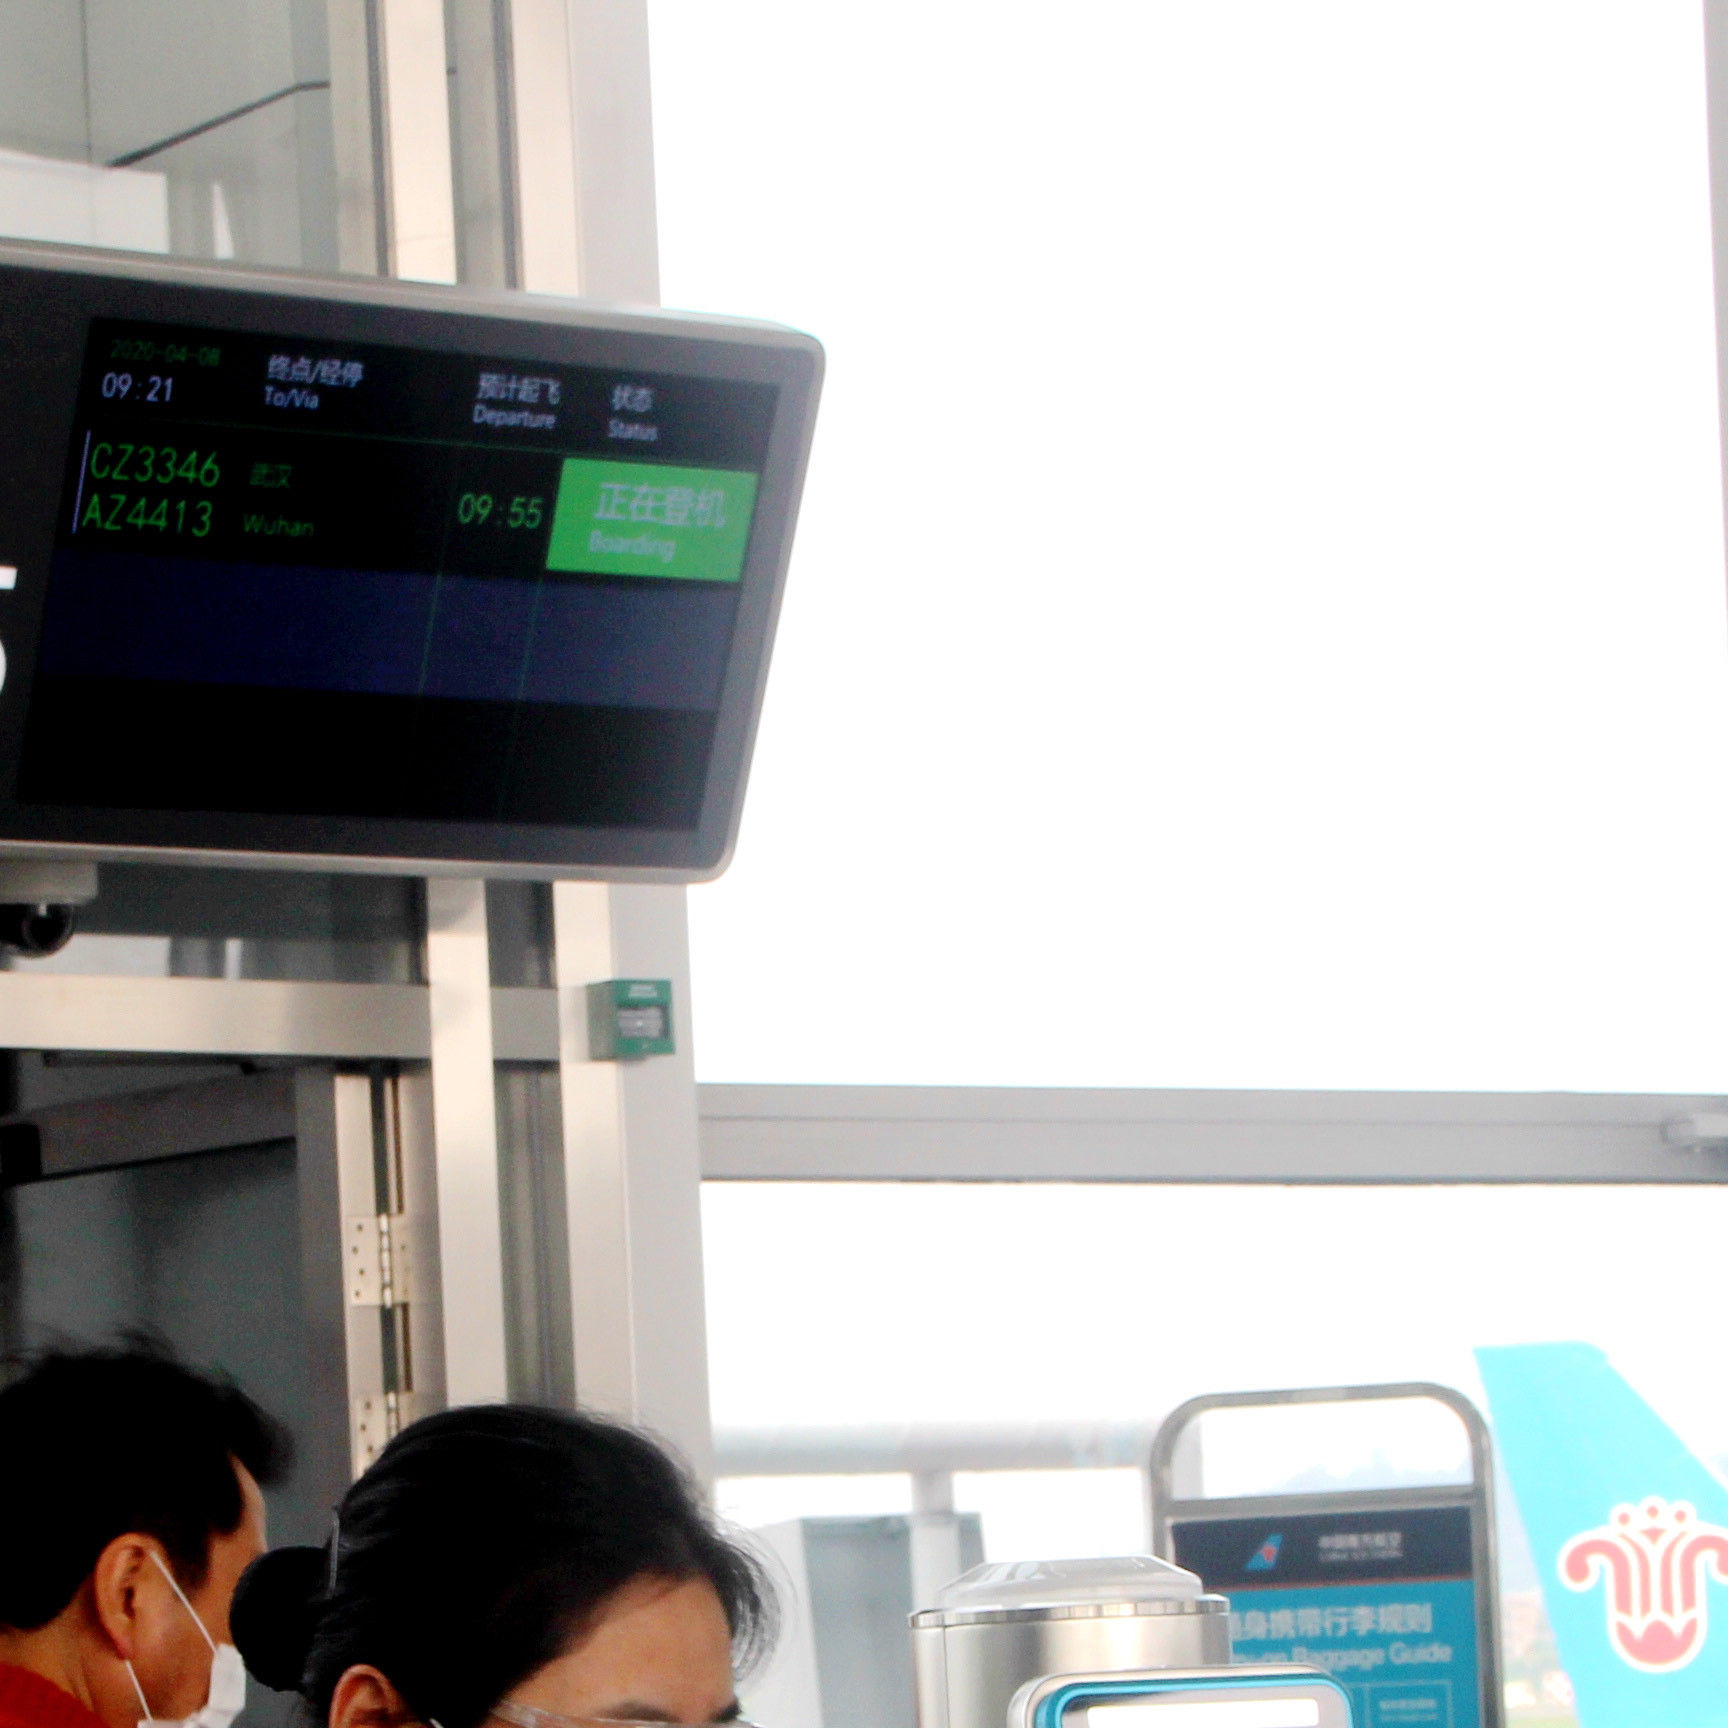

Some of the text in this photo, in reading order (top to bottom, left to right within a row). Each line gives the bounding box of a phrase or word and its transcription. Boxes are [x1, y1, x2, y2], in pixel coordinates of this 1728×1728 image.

[101, 372, 174, 403] 09:21
[90, 443, 221, 488] CZ3346
[82, 493, 214, 538] AZ4413
[457, 494, 543, 530] 09:55
